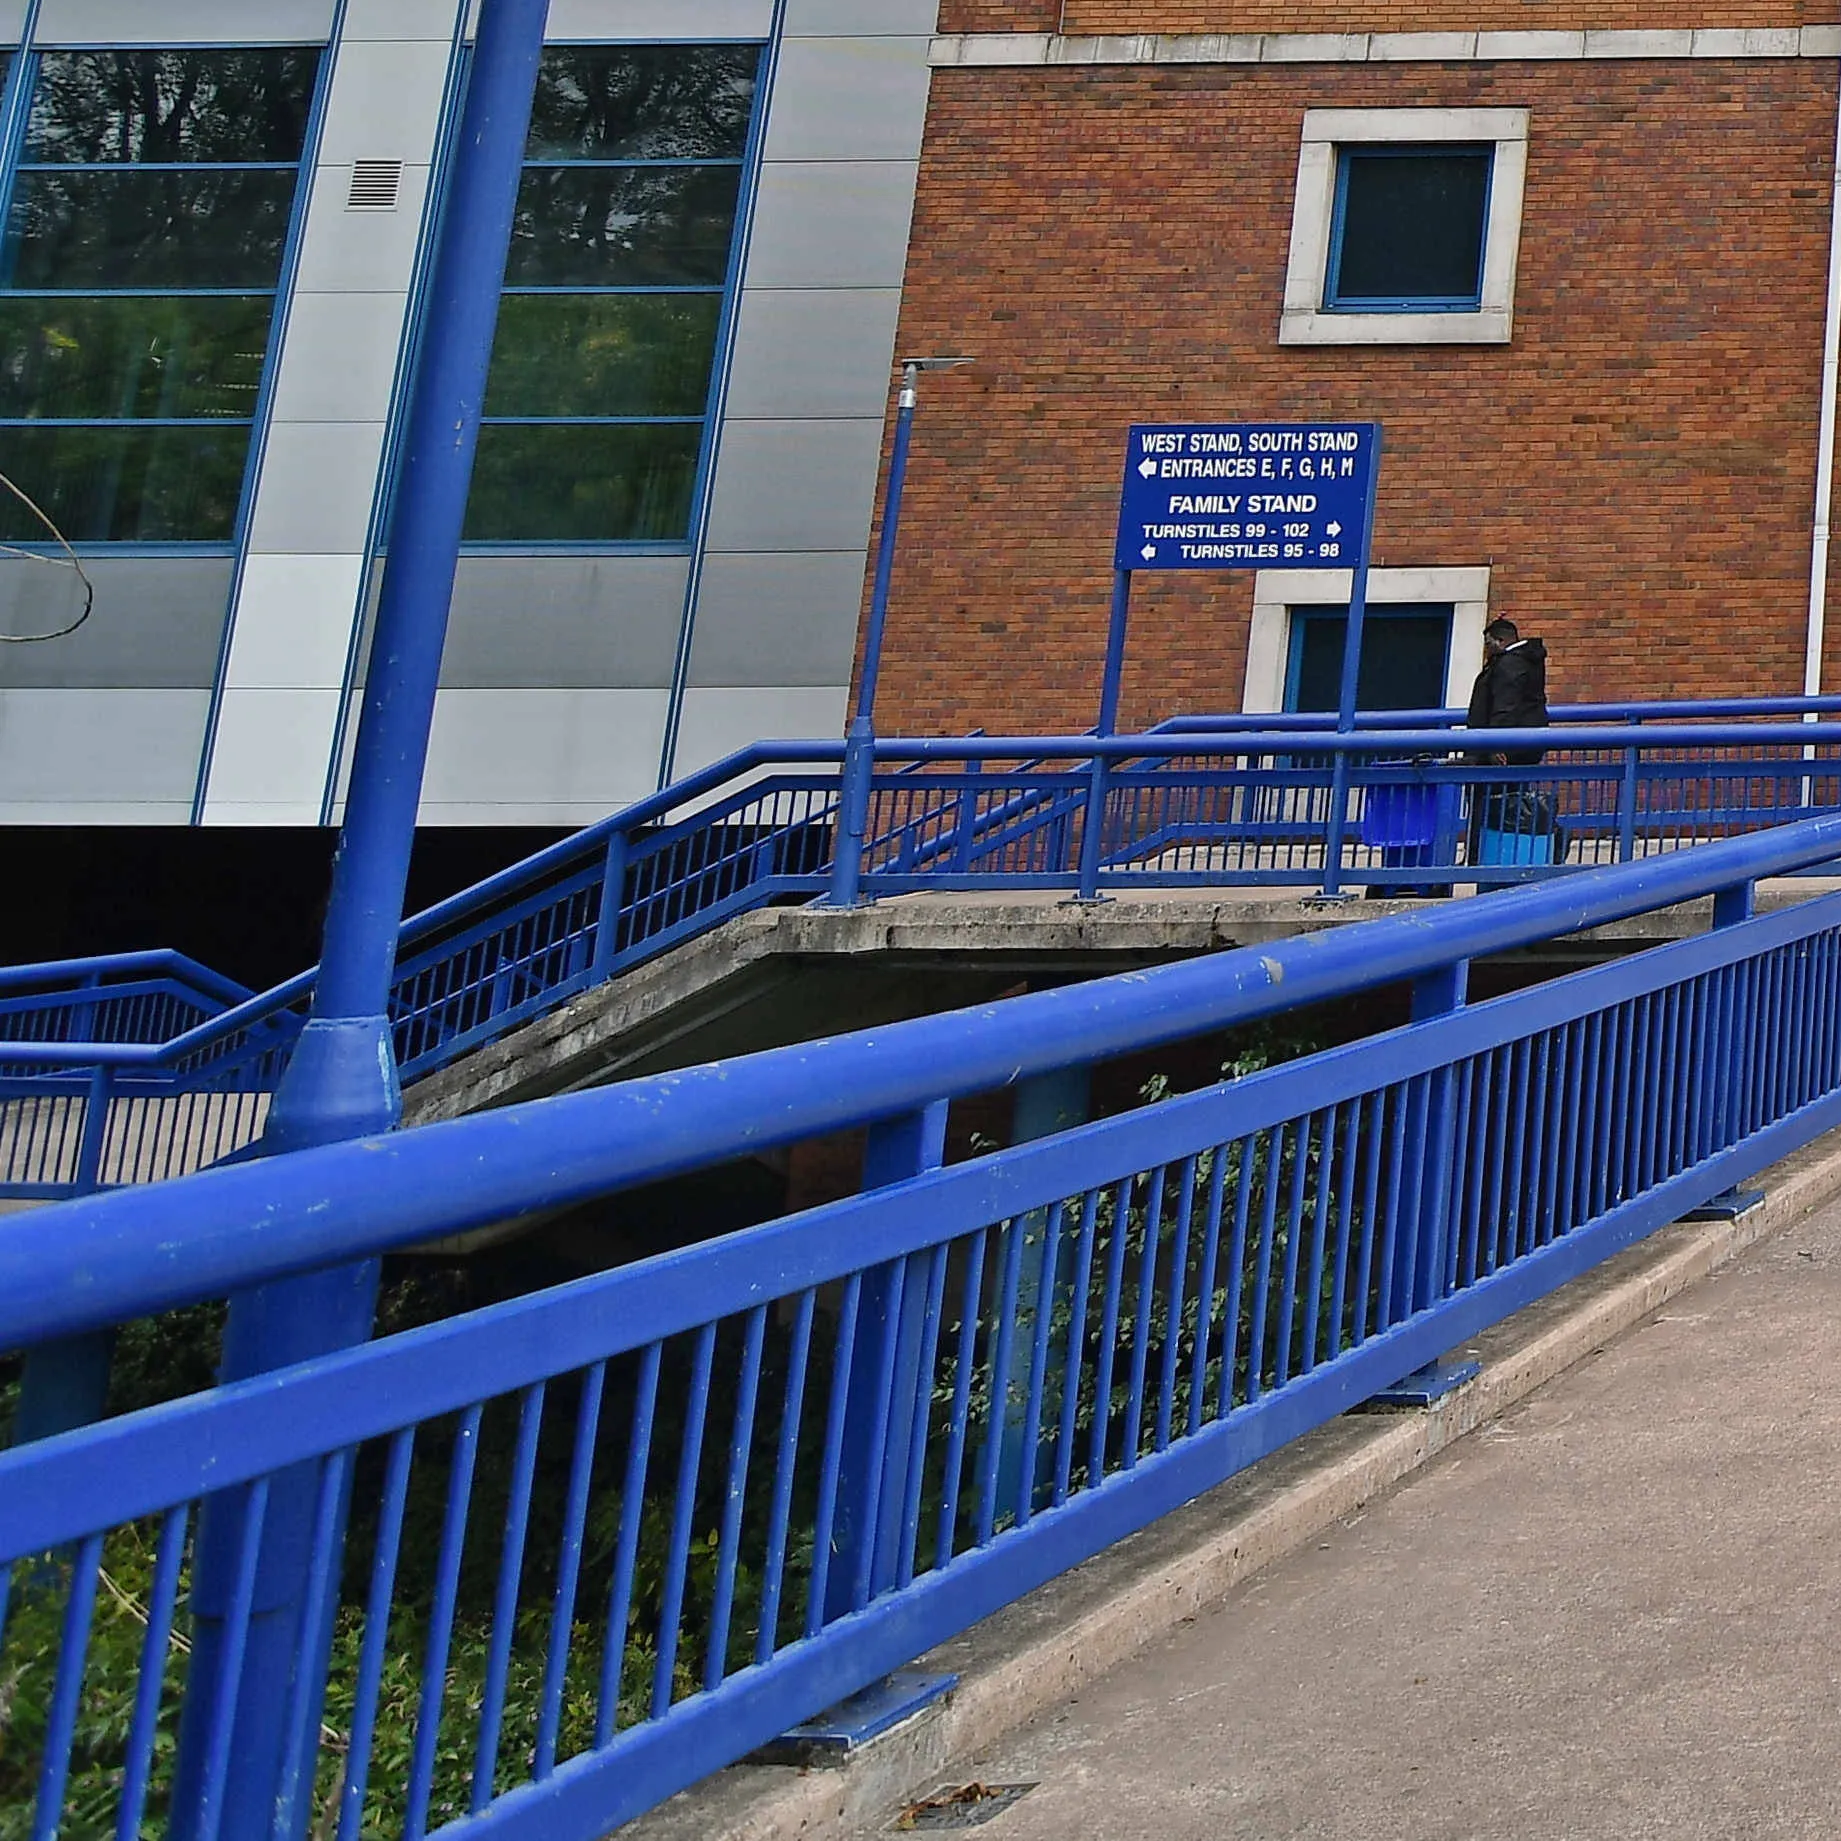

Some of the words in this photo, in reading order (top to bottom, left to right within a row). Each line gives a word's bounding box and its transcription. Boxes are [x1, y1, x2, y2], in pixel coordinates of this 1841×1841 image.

[1142, 433, 1185, 452] WEST
[1190, 433, 1243, 455] STAND,
[1249, 433, 1303, 452] SOUTH
[1308, 432, 1358, 451] STAND
[1161, 458, 1256, 478] ENTRANCES
[1261, 458, 1275, 480] E,
[1281, 458, 1293, 480] F,
[1299, 458, 1315, 480] G,
[1321, 458, 1336, 480] H,
[1341, 457, 1353, 476] M
[1169, 496, 1241, 514] FAMILY
[1247, 495, 1317, 513] STAND
[1142, 524, 1240, 538] TURNSTILES
[1245, 524, 1266, 538] 99
[1283, 523, 1309, 537] 102
[1180, 544, 1279, 559] TURNSTILES
[1283, 544, 1303, 558] 95
[1319, 543, 1340, 557] 98
